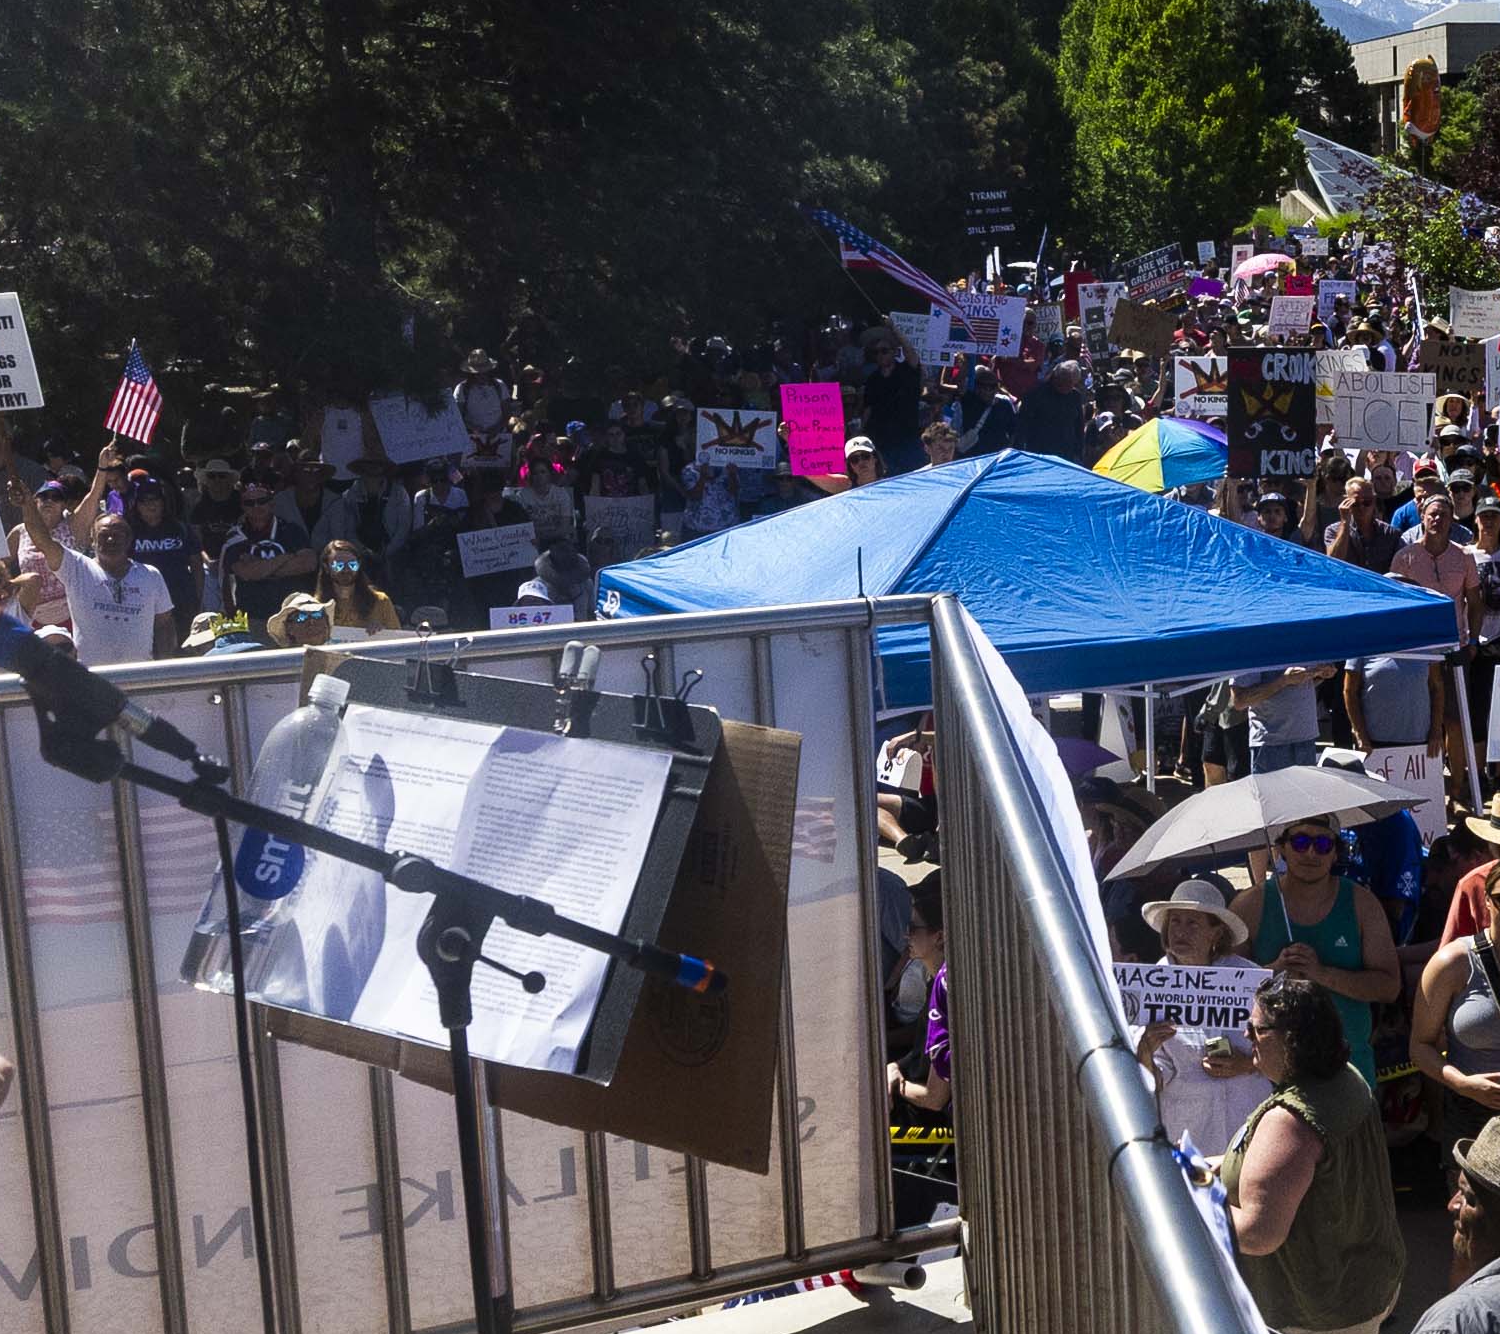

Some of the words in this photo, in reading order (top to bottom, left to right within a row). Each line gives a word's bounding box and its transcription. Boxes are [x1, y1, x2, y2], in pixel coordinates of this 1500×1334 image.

[1138, 260, 1155, 274] ARE
[1130, 270, 1159, 286] GREAT
[1336, 371, 1436, 395] ABOLISH
[786, 387, 831, 404] Prison
[1193, 395, 1207, 404] NO
[1336, 395, 1434, 446] ICE!
[714, 447, 728, 456] NO
[729, 447, 757, 456] KINGS
[799, 456, 834, 472] Camp
[1260, 448, 1315, 477] KING
[508, 611, 528, 625] 86
[531, 610, 552, 625] 47
[1403, 754, 1427, 781] All
[1143, 992, 1153, 1004] A
[1153, 992, 1195, 1005] WORLD
[1195, 994, 1250, 1007] WITHOUT
[1143, 1003, 1252, 1029] TRUMP
